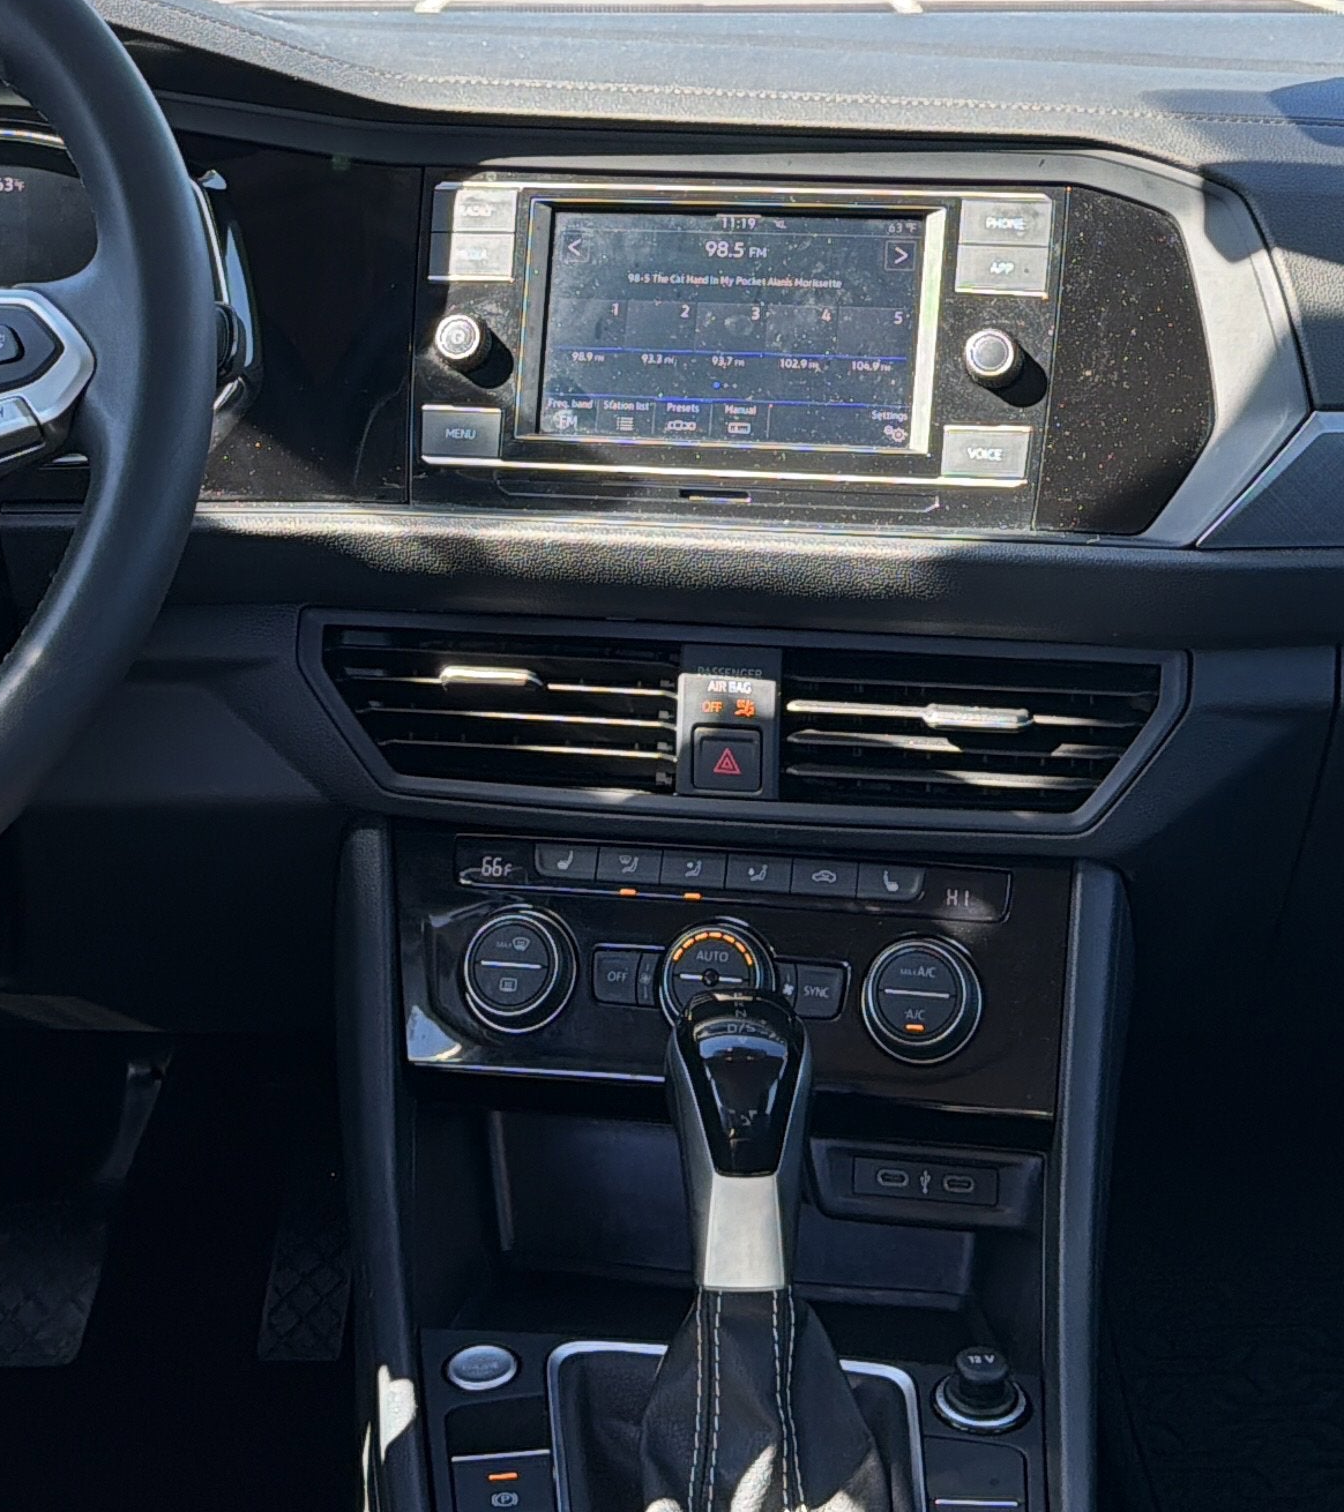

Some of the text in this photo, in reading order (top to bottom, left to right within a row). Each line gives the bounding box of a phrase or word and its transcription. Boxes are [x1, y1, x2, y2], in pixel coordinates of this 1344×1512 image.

[721, 217, 756, 229] 11:19
[705, 240, 768, 258] 98.5 FM
[735, 276, 766, 287] Pocket
[794, 278, 843, 288] Morissette
[611, 303, 904, 325] 1 2 3 4 5
[779, 358, 808, 369] 102.9
[571, 399, 593, 410] band
[603, 400, 634, 411] Station
[666, 402, 700, 414] Presets
[724, 404, 757, 416] Manual
[871, 409, 908, 422] Settings
[445, 427, 477, 440] MENU
[967, 447, 1003, 462] VOICE
[707, 679, 752, 694] AIR BAG
[702, 700, 723, 713] OFF
[695, 950, 730, 963] AUTO
[607, 970, 629, 982] OFF
[803, 986, 830, 999] SYNC
[904, 1009, 926, 1021] A/C
